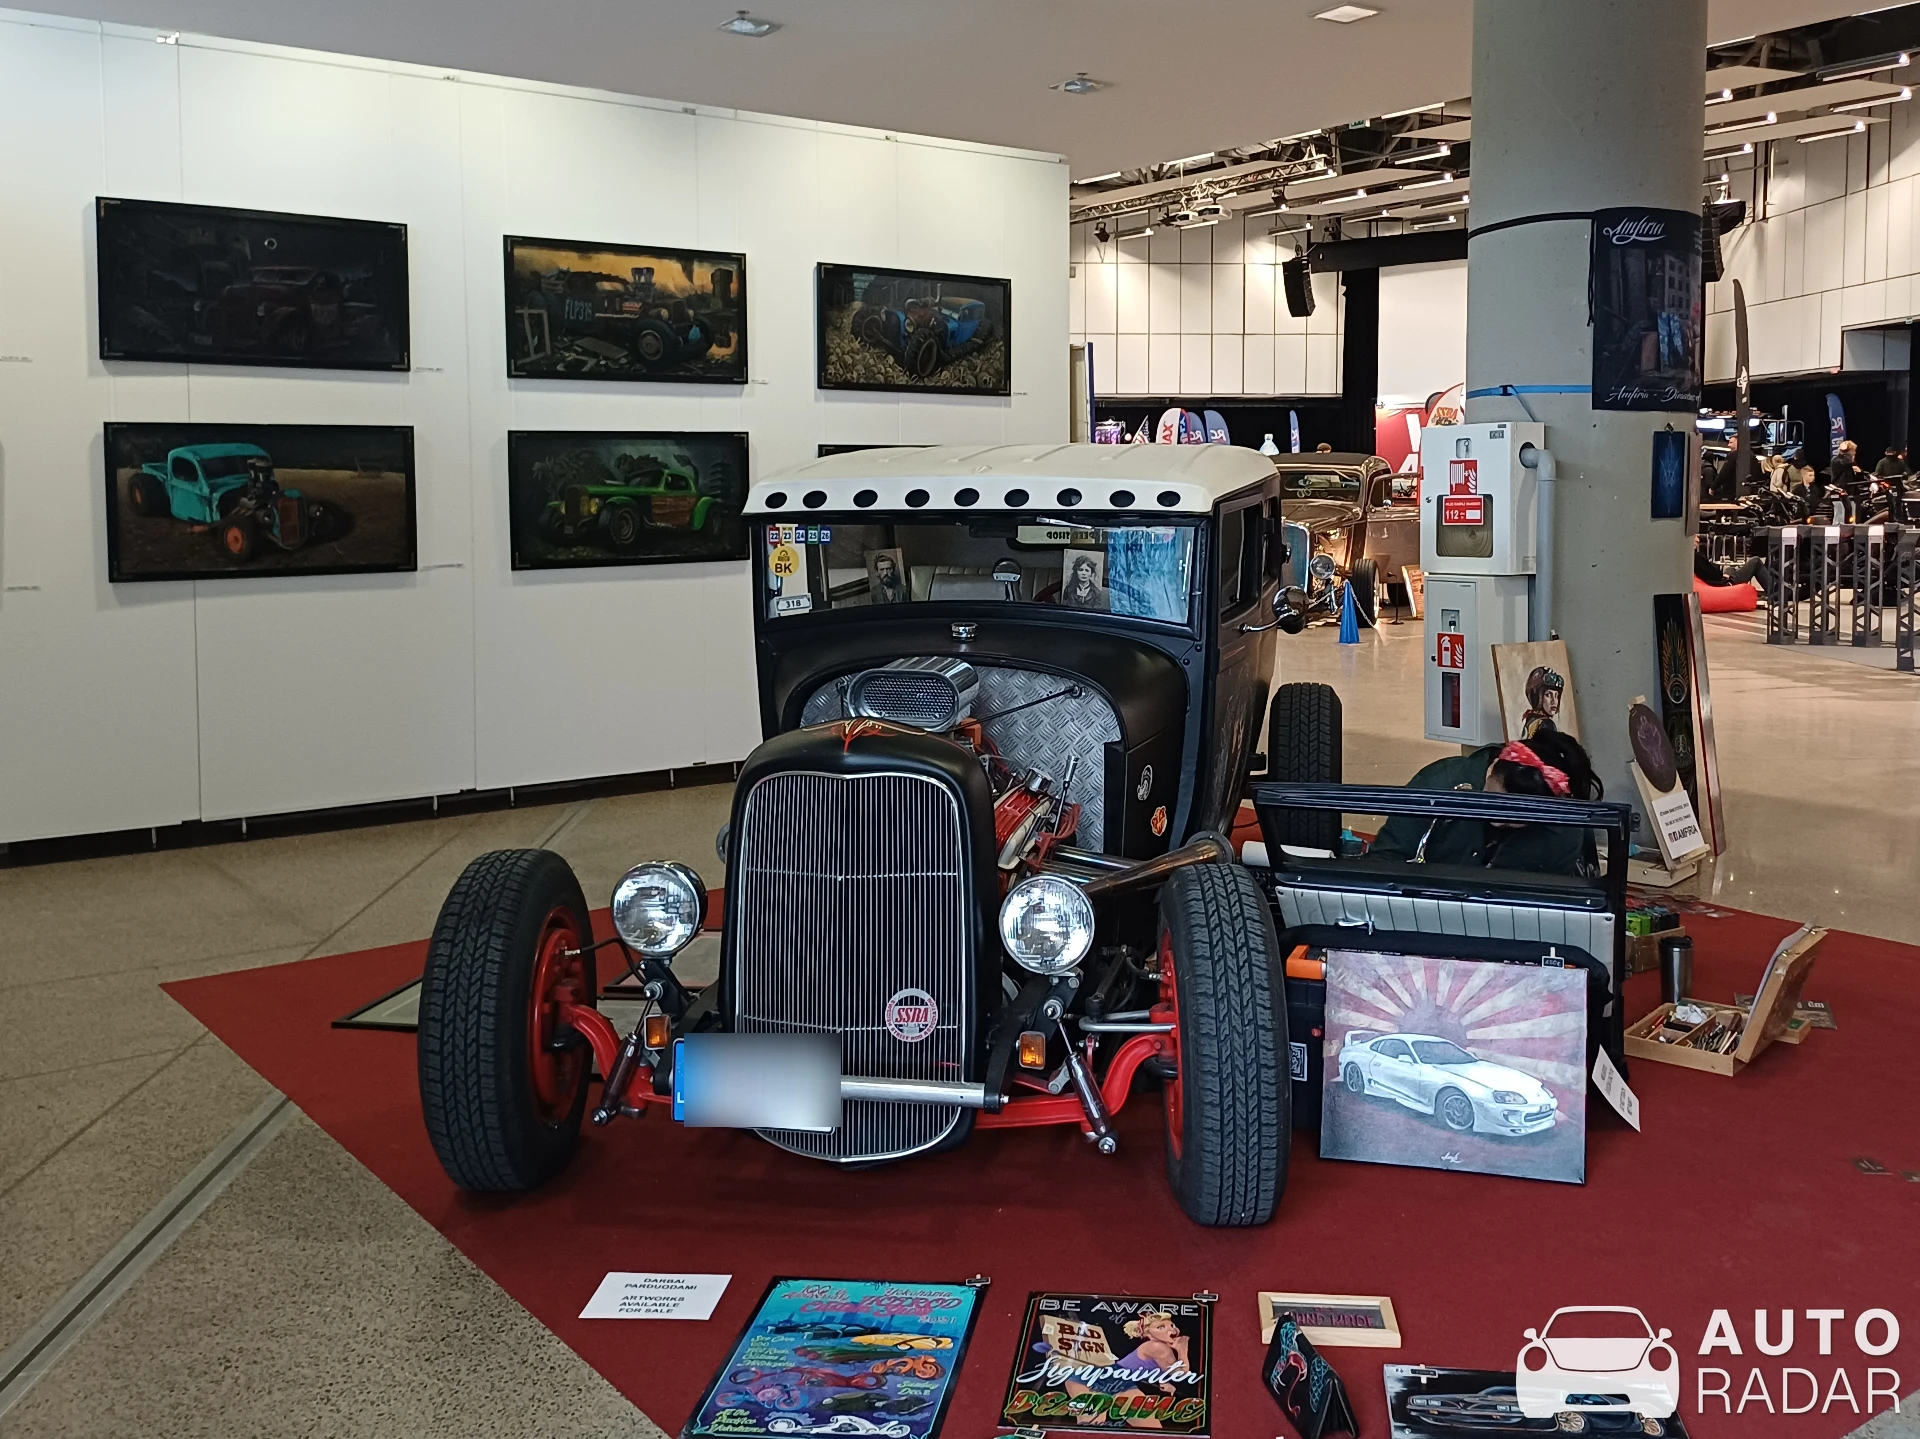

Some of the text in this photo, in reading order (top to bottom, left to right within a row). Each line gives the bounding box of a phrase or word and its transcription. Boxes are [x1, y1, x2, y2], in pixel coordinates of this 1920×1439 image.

[1445, 510, 1459, 520] 112
[770, 531, 829, 540] 22 23 24 25 26
[774, 562, 793, 574] BK
[785, 599, 802, 608] 318
[895, 1007, 929, 1023] SSRA
[1039, 1299, 1199, 1317] BE AWARE
[1057, 1322, 1102, 1340] BAD
[1057, 1338, 1105, 1354] SIGN
